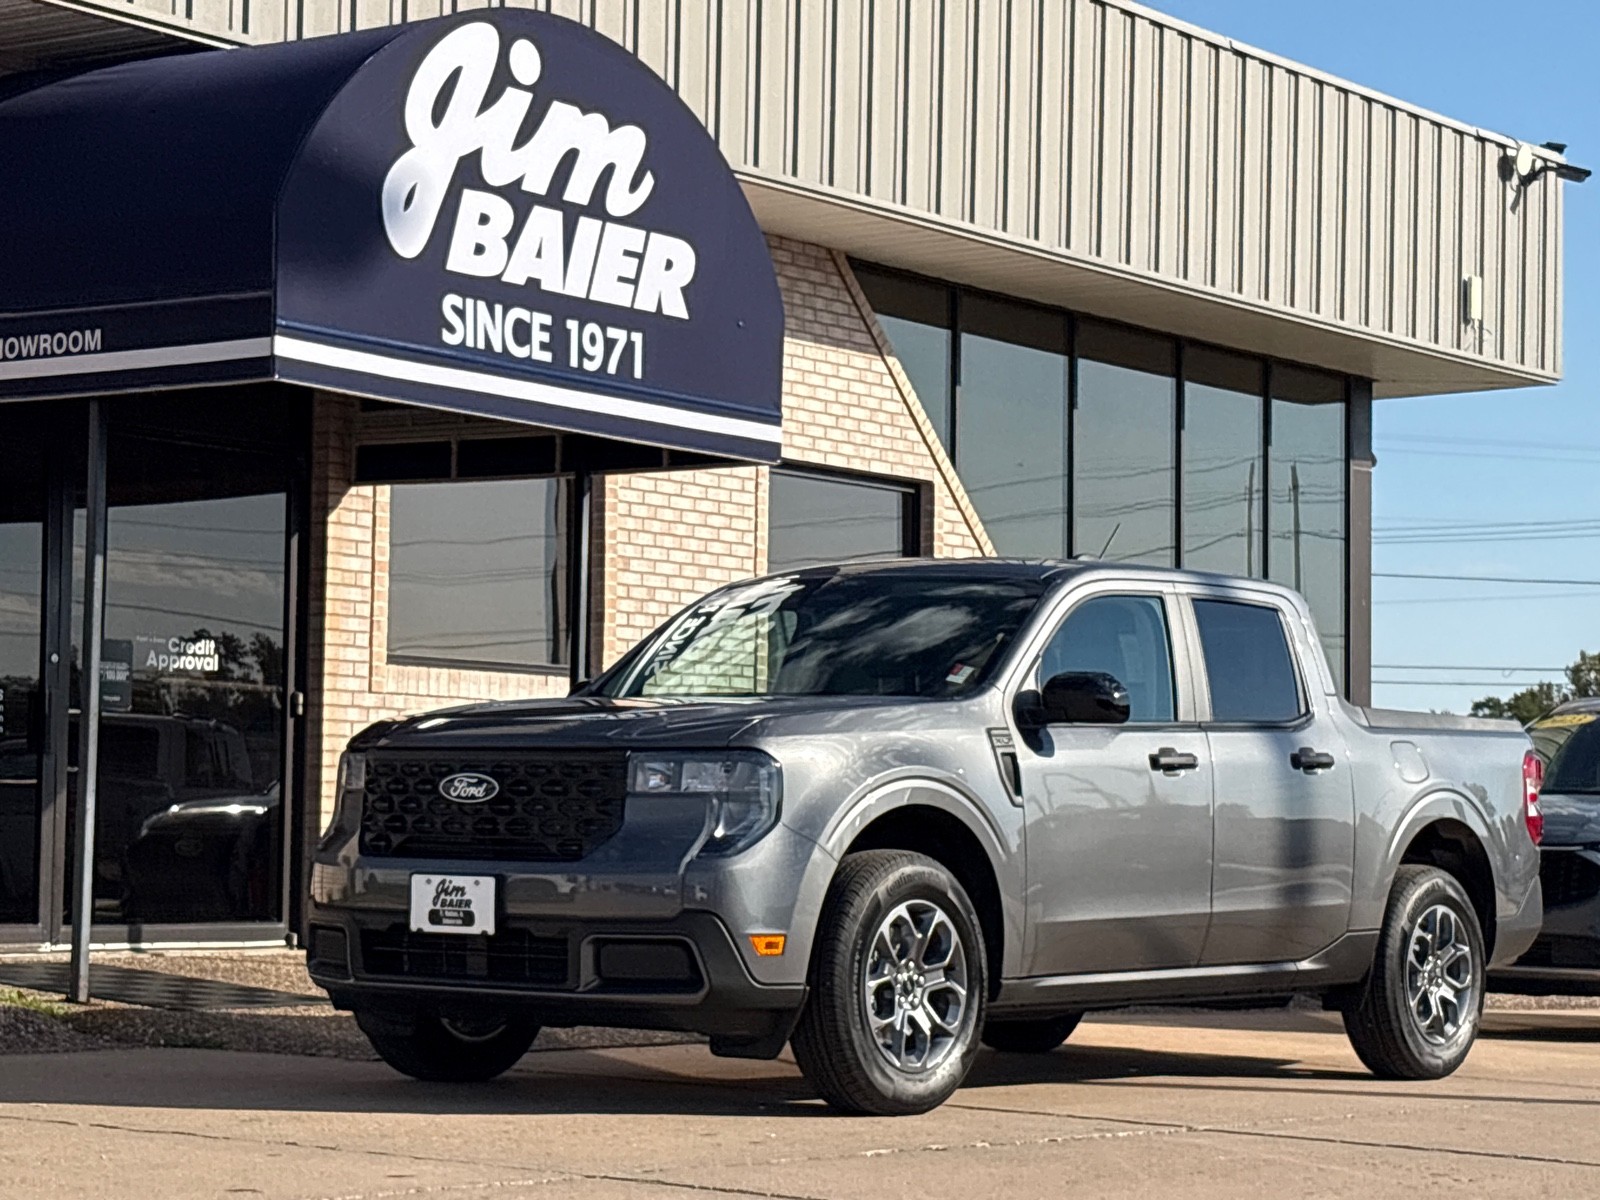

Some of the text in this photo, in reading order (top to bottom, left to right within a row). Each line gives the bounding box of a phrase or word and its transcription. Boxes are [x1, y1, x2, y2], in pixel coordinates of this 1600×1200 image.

[382, 22, 655, 259] Jim
[445, 188, 696, 320] BAIER
[0, 328, 102, 360] OWROOM
[441, 293, 644, 380] SINCE 1971
[168, 637, 216, 655] Credit
[146, 652, 219, 672] Approval
[450, 776, 488, 798] Ford
[432, 878, 467, 907] Jim
[440, 898, 473, 909] BAIER
